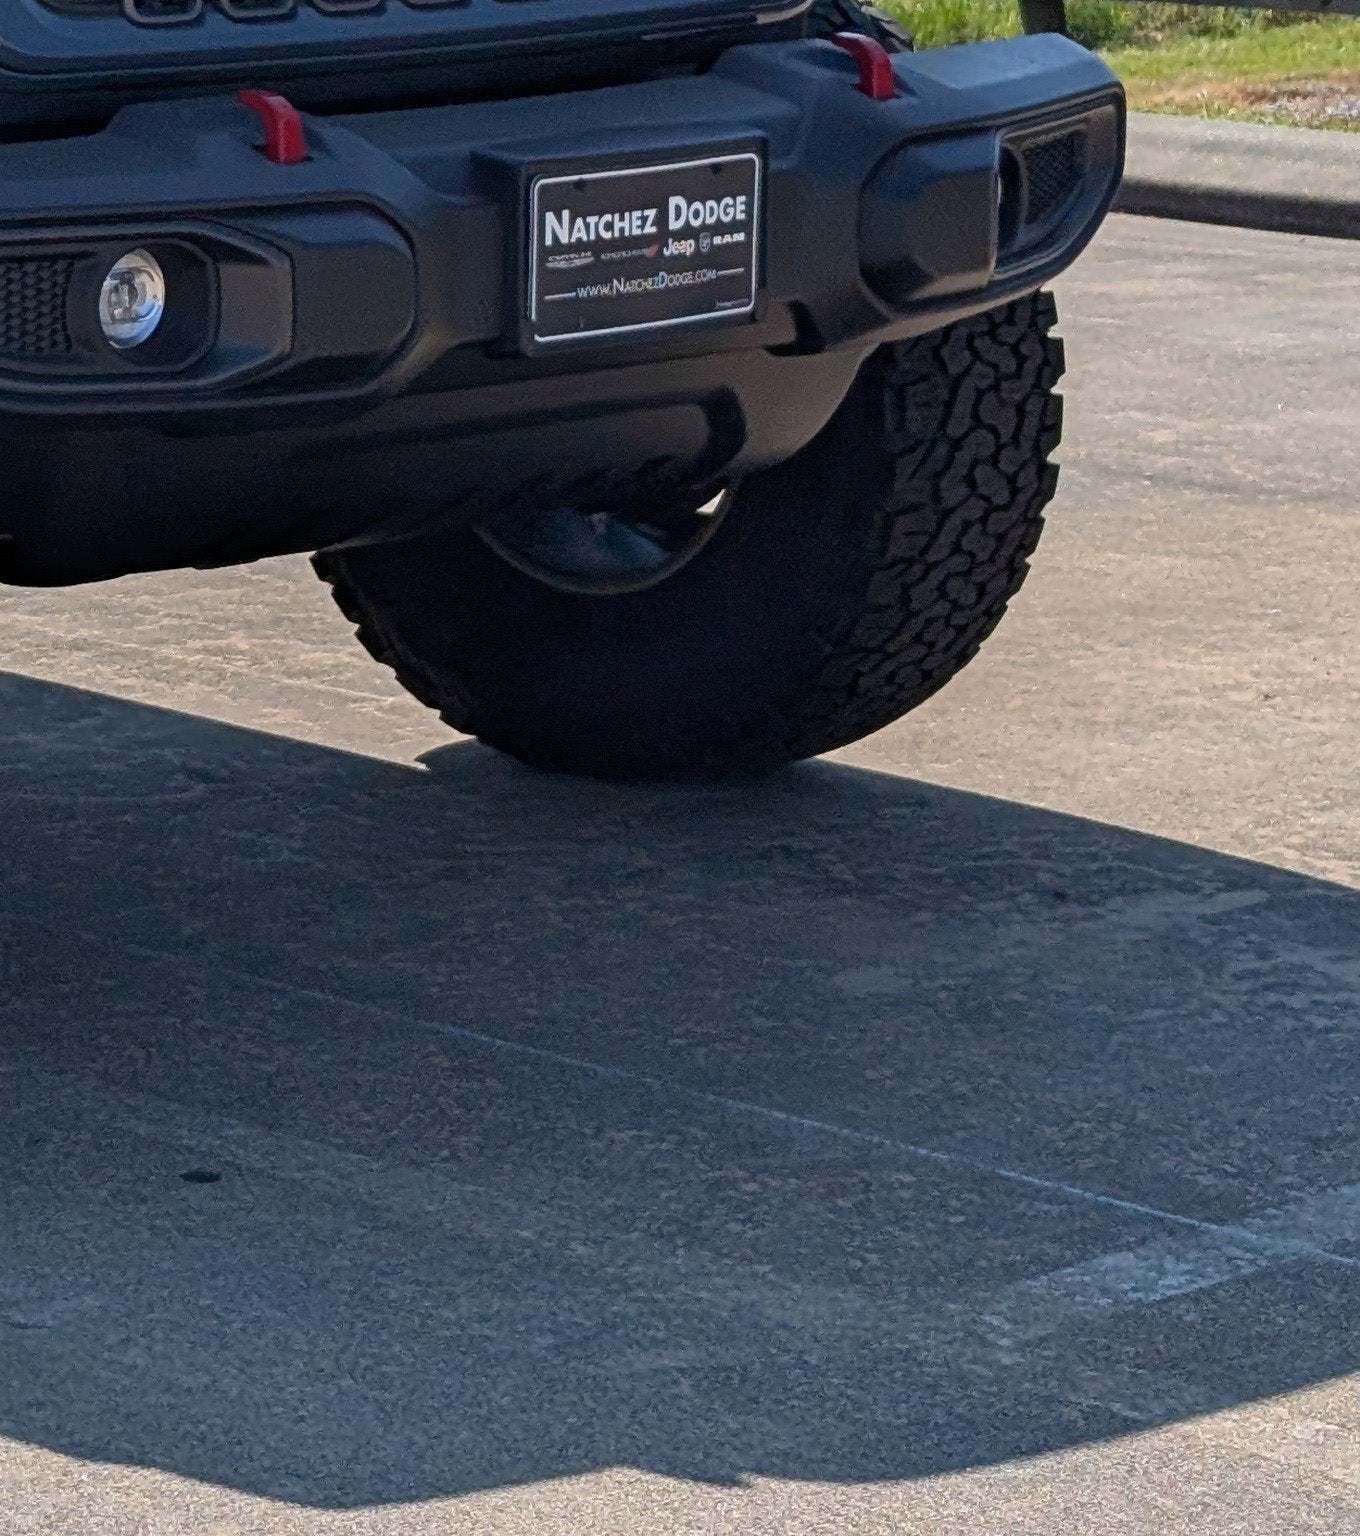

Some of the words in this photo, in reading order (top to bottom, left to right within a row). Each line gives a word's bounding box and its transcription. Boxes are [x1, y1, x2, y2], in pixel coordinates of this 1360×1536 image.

[544, 208, 658, 246] NATCHEZ
[668, 195, 747, 232] DODGE
[663, 237, 695, 256] Jeep
[713, 232, 745, 245] RAM
